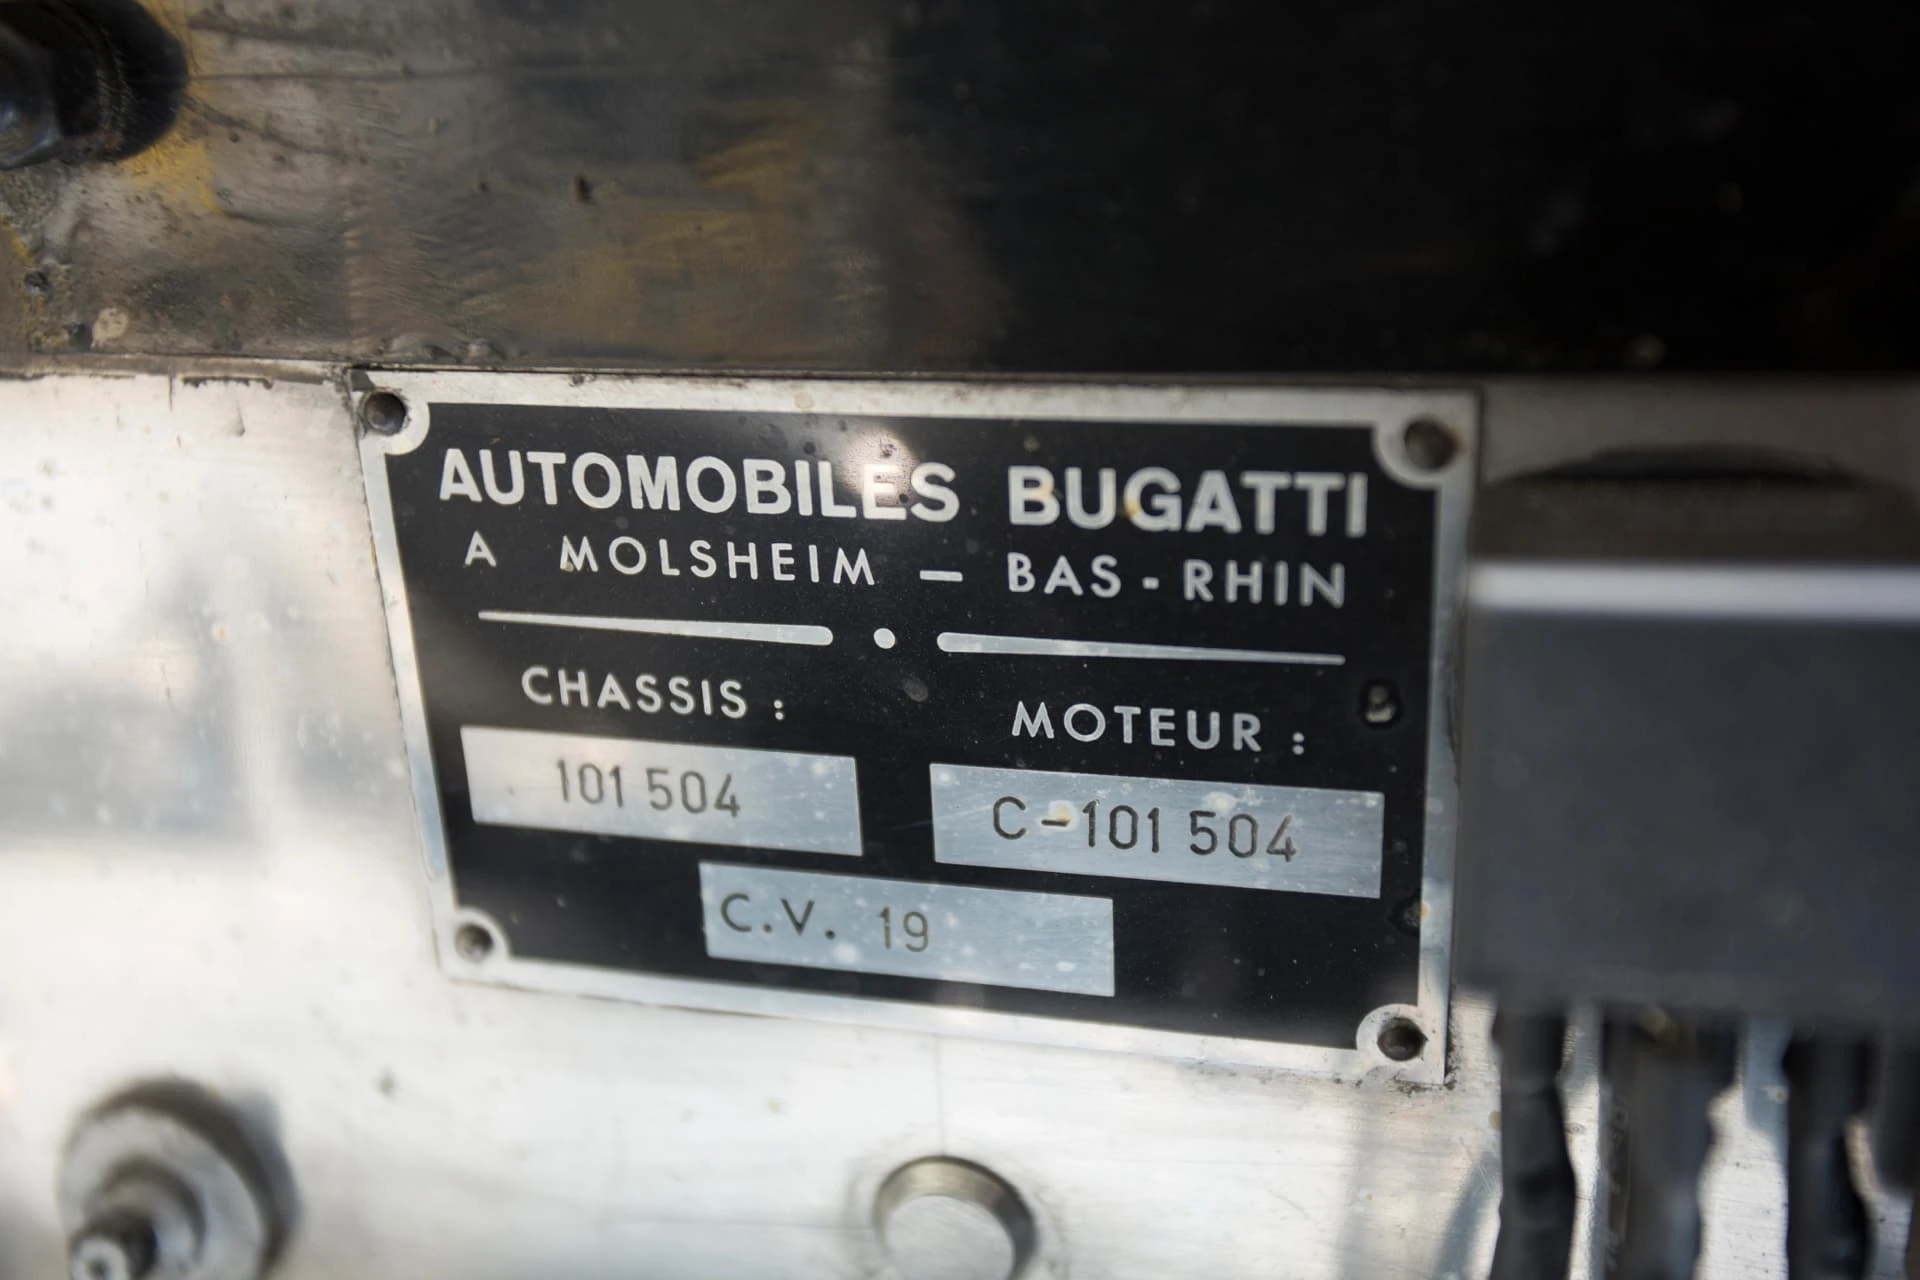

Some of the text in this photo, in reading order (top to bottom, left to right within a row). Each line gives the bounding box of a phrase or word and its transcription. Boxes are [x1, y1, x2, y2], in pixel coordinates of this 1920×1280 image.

[440, 448, 1368, 536] AUTOMOBILES BUGATTI
[465, 531, 497, 567] A
[560, 536, 875, 586] MOLSHEIM
[521, 666, 747, 719] CHASSIS
[1012, 701, 1262, 751] MOTEUR
[721, 893, 929, 952] C.V. 19
